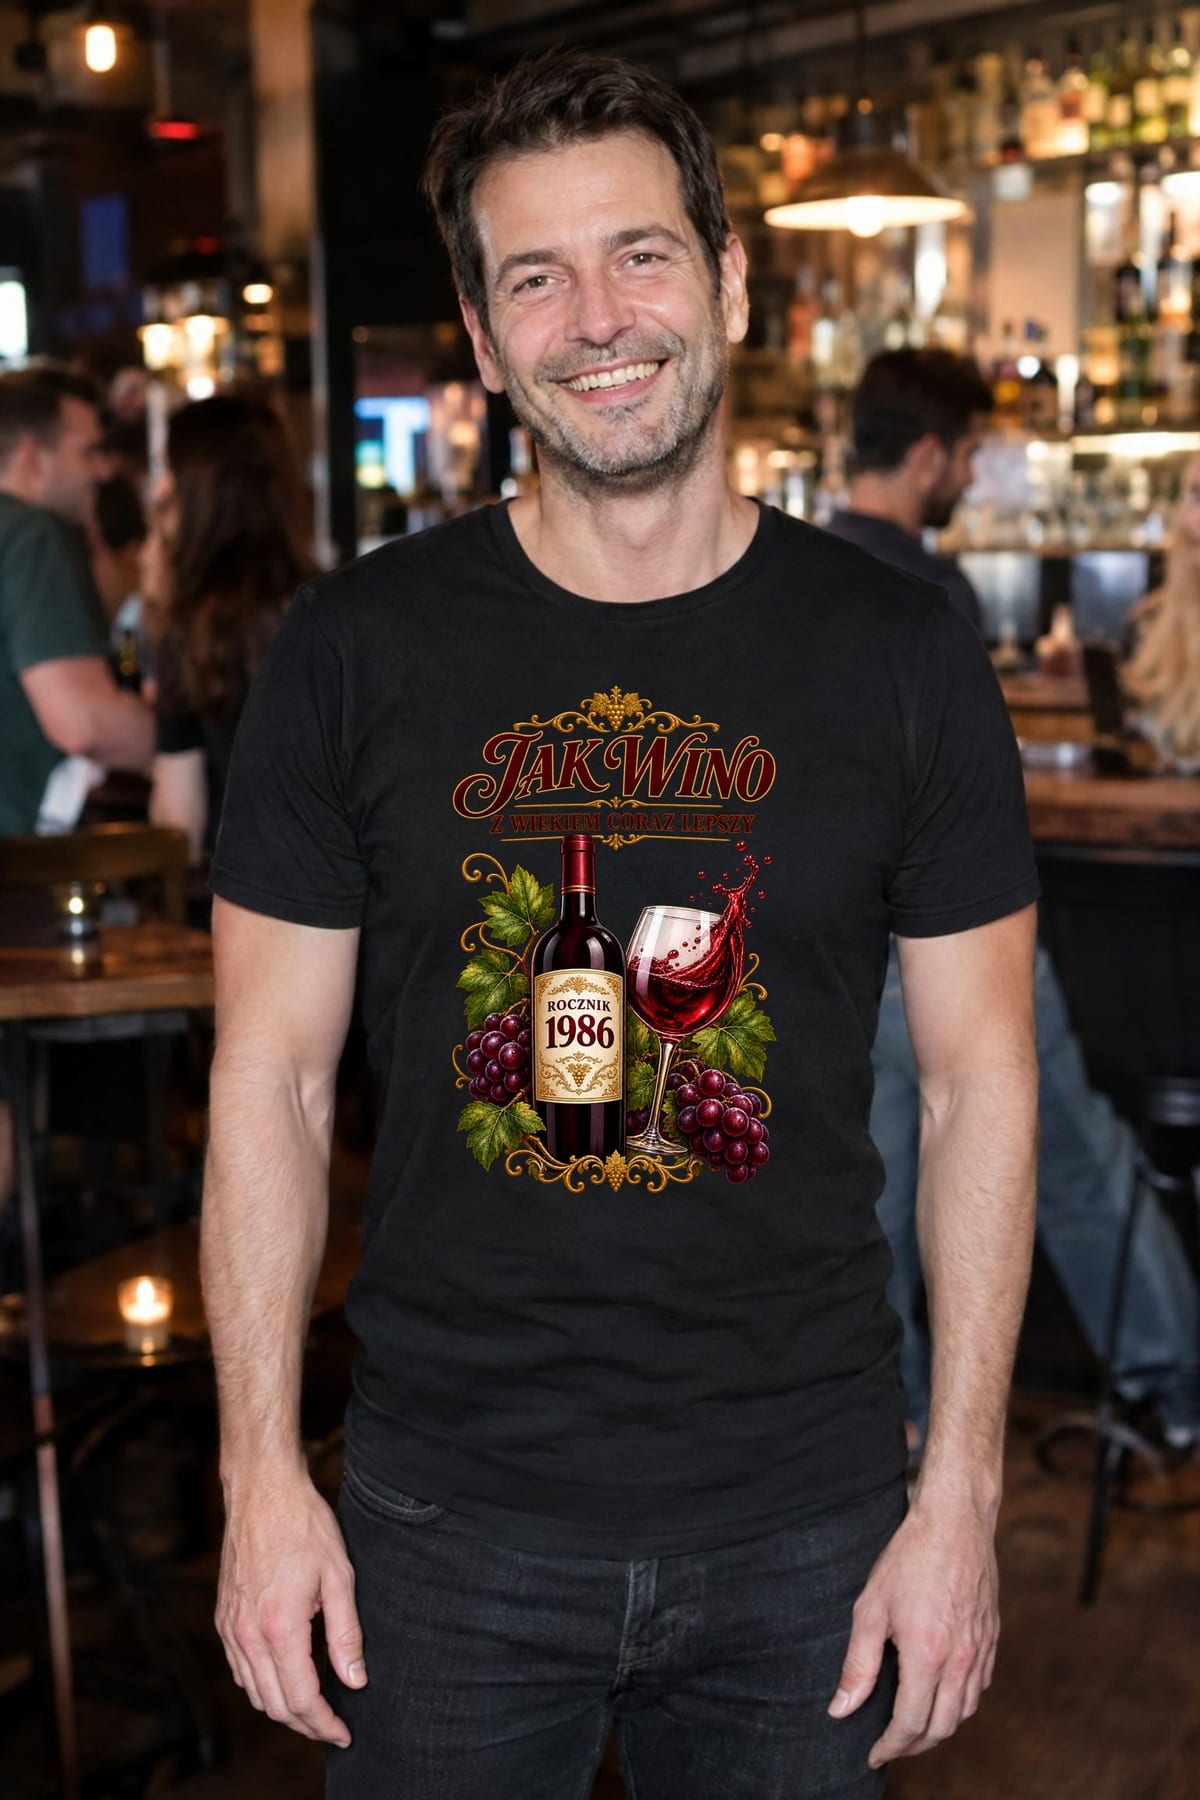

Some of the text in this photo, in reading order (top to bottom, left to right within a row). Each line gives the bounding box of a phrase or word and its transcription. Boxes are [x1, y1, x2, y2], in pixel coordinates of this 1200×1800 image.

[452, 730, 776, 819] JAK WINO
[489, 812, 756, 834] Z WIEKIEM CORAZ LEPSZY
[547, 998, 611, 1012] ROCZNIK
[545, 1014, 615, 1049] 1986
